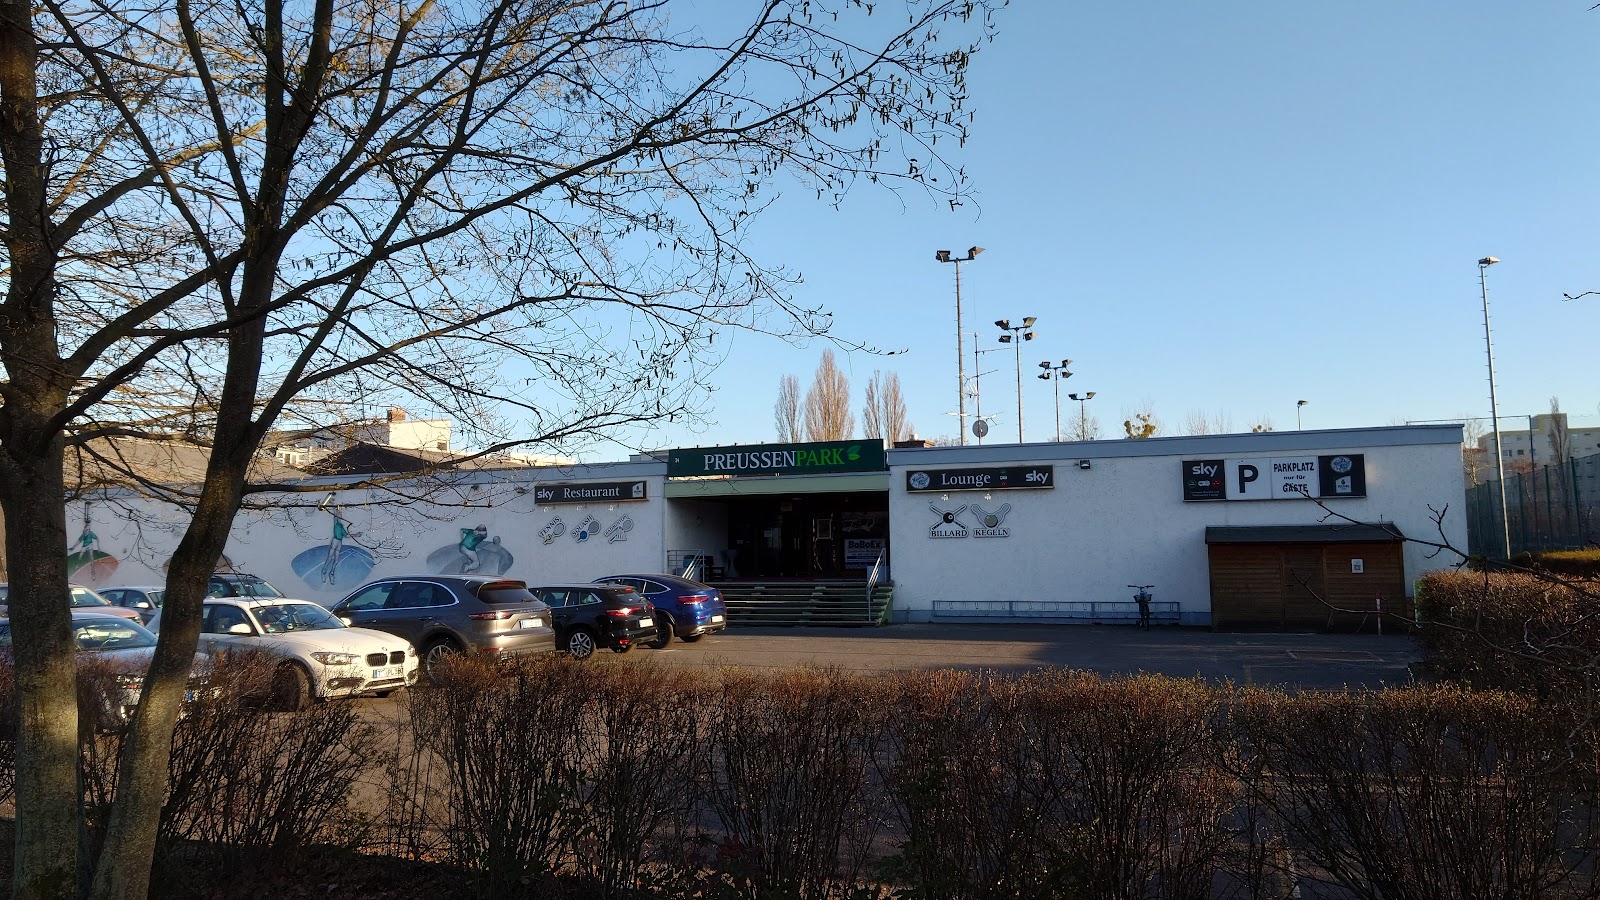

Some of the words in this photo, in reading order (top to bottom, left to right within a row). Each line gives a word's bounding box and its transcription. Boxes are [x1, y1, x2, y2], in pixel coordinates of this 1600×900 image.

[703, 448, 845, 470] PREUSSENPARK
[1273, 462, 1315, 472] PARKPLATZ
[941, 473, 991, 487] Lounge
[1025, 470, 1049, 484] sky
[1192, 463, 1218, 477] sky
[1238, 464, 1259, 493] P
[537, 488, 554, 500] sky
[564, 486, 620, 499] Restaurant
[540, 516, 560, 537] TENNIS
[572, 514, 595, 537] SQUASH
[931, 529, 968, 537] BILLARD
